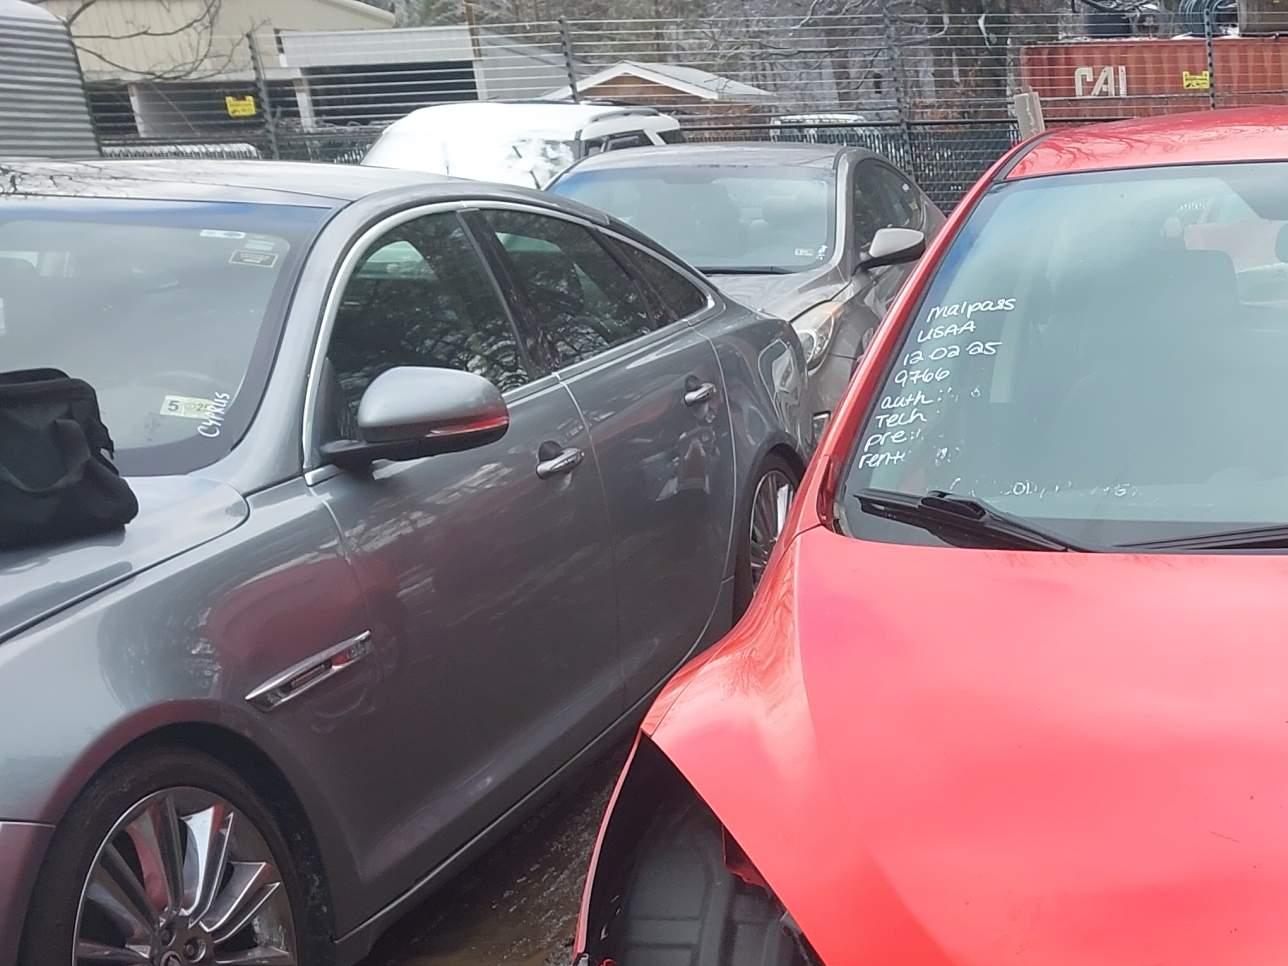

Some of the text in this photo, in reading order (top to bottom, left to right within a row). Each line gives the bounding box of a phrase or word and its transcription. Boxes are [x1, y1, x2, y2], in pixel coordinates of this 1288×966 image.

[1074, 65, 1128, 97] CAI
[917, 320, 977, 343] USAA
[894, 367, 951, 388] 9766
[167, 400, 180, 412] 5
[196, 391, 231, 438] CYPRUS
